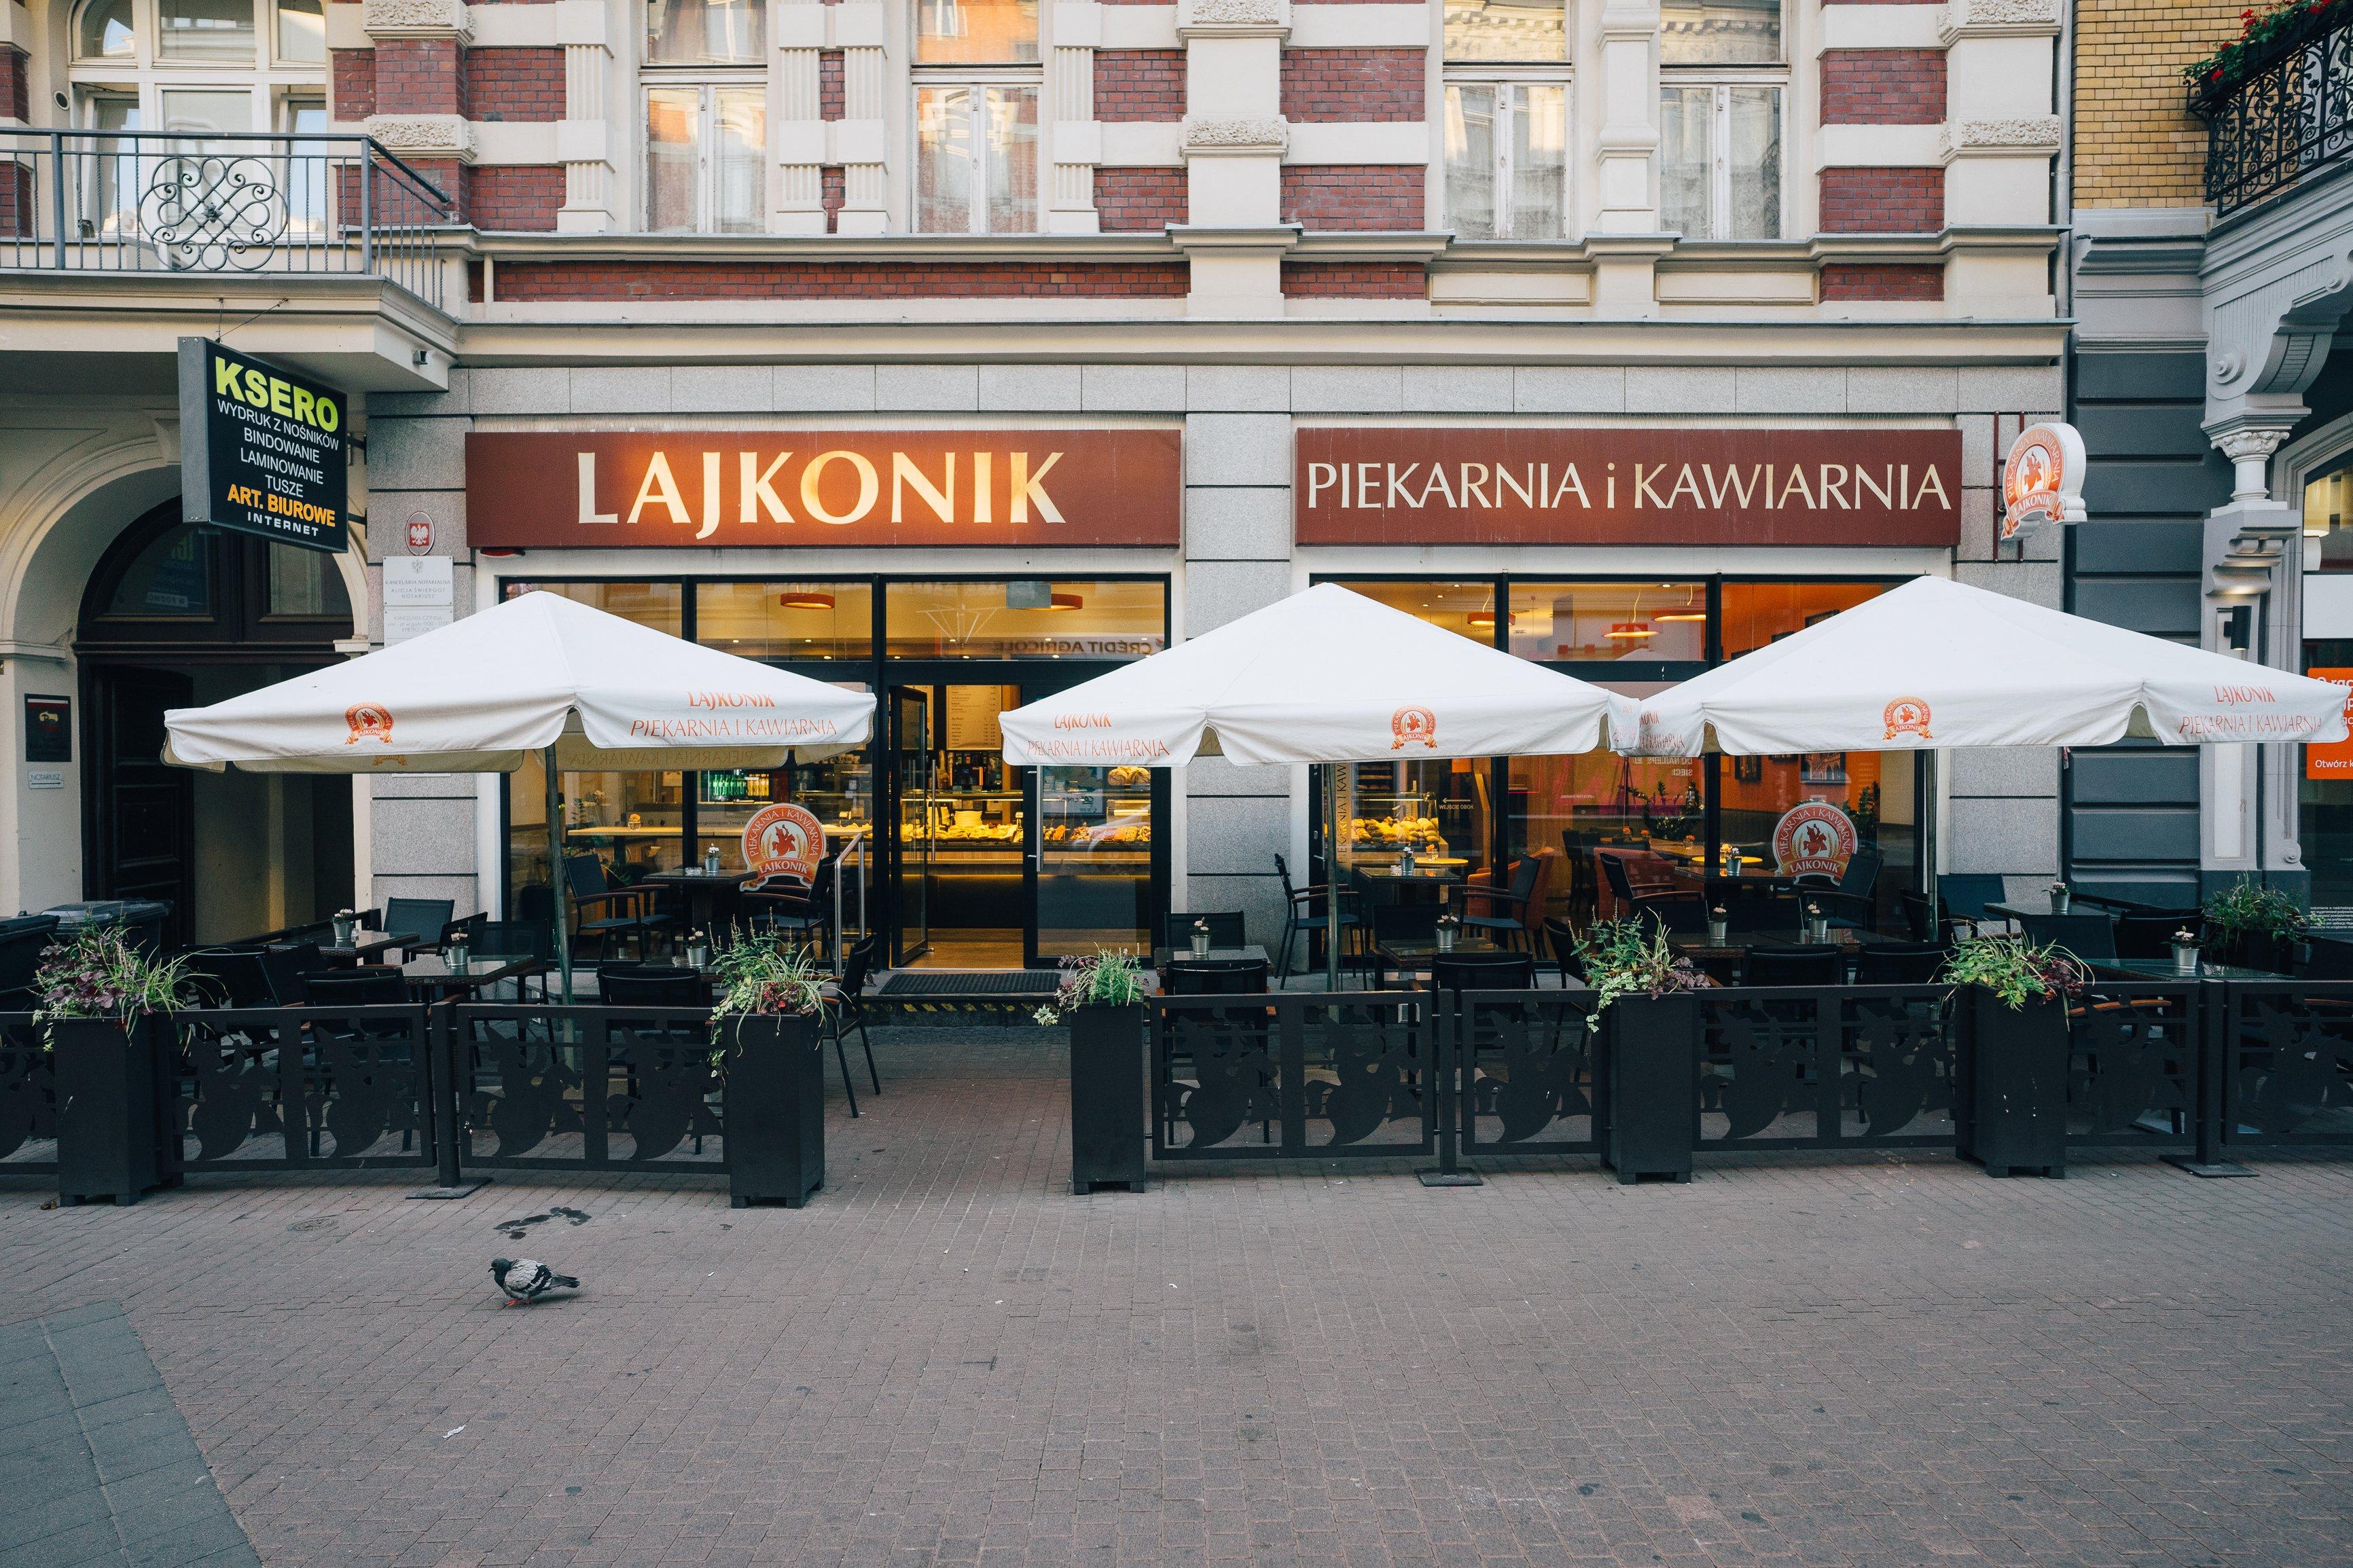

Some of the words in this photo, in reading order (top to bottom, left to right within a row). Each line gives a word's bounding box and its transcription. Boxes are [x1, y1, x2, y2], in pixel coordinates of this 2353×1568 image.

[215, 356, 338, 433] KSERO
[217, 399, 272, 429] WYDRUK
[273, 418, 281, 431] Z
[283, 421, 339, 450] NOŚNIKÓW
[244, 427, 320, 464] BINDOWANIE
[240, 448, 323, 484] LAMINOWANIE
[2007, 437, 2030, 498] PIEKARNIA
[2035, 431, 2060, 482] KAWIARNIA
[265, 474, 304, 498] TUSZE
[578, 450, 1066, 539] LAJKONIK
[1308, 462, 1591, 509] PIEKARNIA
[1607, 462, 1615, 509] i
[1634, 463, 1952, 510] KAWIARNIA
[228, 484, 264, 509] ART.
[268, 493, 336, 528] BIUROWE
[2014, 494, 2053, 515] LAJKONIK
[247, 511, 319, 536] INTERNET
[687, 691, 776, 710] LAJKONIK
[2214, 685, 2276, 706] LAJKONIK
[630, 718, 730, 737] PIEKARNIA
[736, 720, 739, 735] I
[747, 718, 837, 735] KAWIARNIA
[1054, 713, 1113, 732] LAJKONIK
[1639, 710, 1659, 727] KONIK
[2178, 715, 2244, 734] PIEKARNIA
[2257, 715, 2322, 733] KAWIARNIA
[1028, 739, 1082, 756] PIEKARNIA
[1092, 739, 1170, 756] KAWIARNIA
[2315, 759, 2347, 767] Otwórz
[749, 811, 779, 856] PIEKARNIA
[787, 809, 820, 856] KAWIARNIA
[1780, 809, 1810, 856] PIEKARNIA
[1819, 809, 1851, 855] KAWIARNIA
[758, 861, 809, 873] LAJKONIK
[1790, 860, 1840, 873] LAJKONIK
